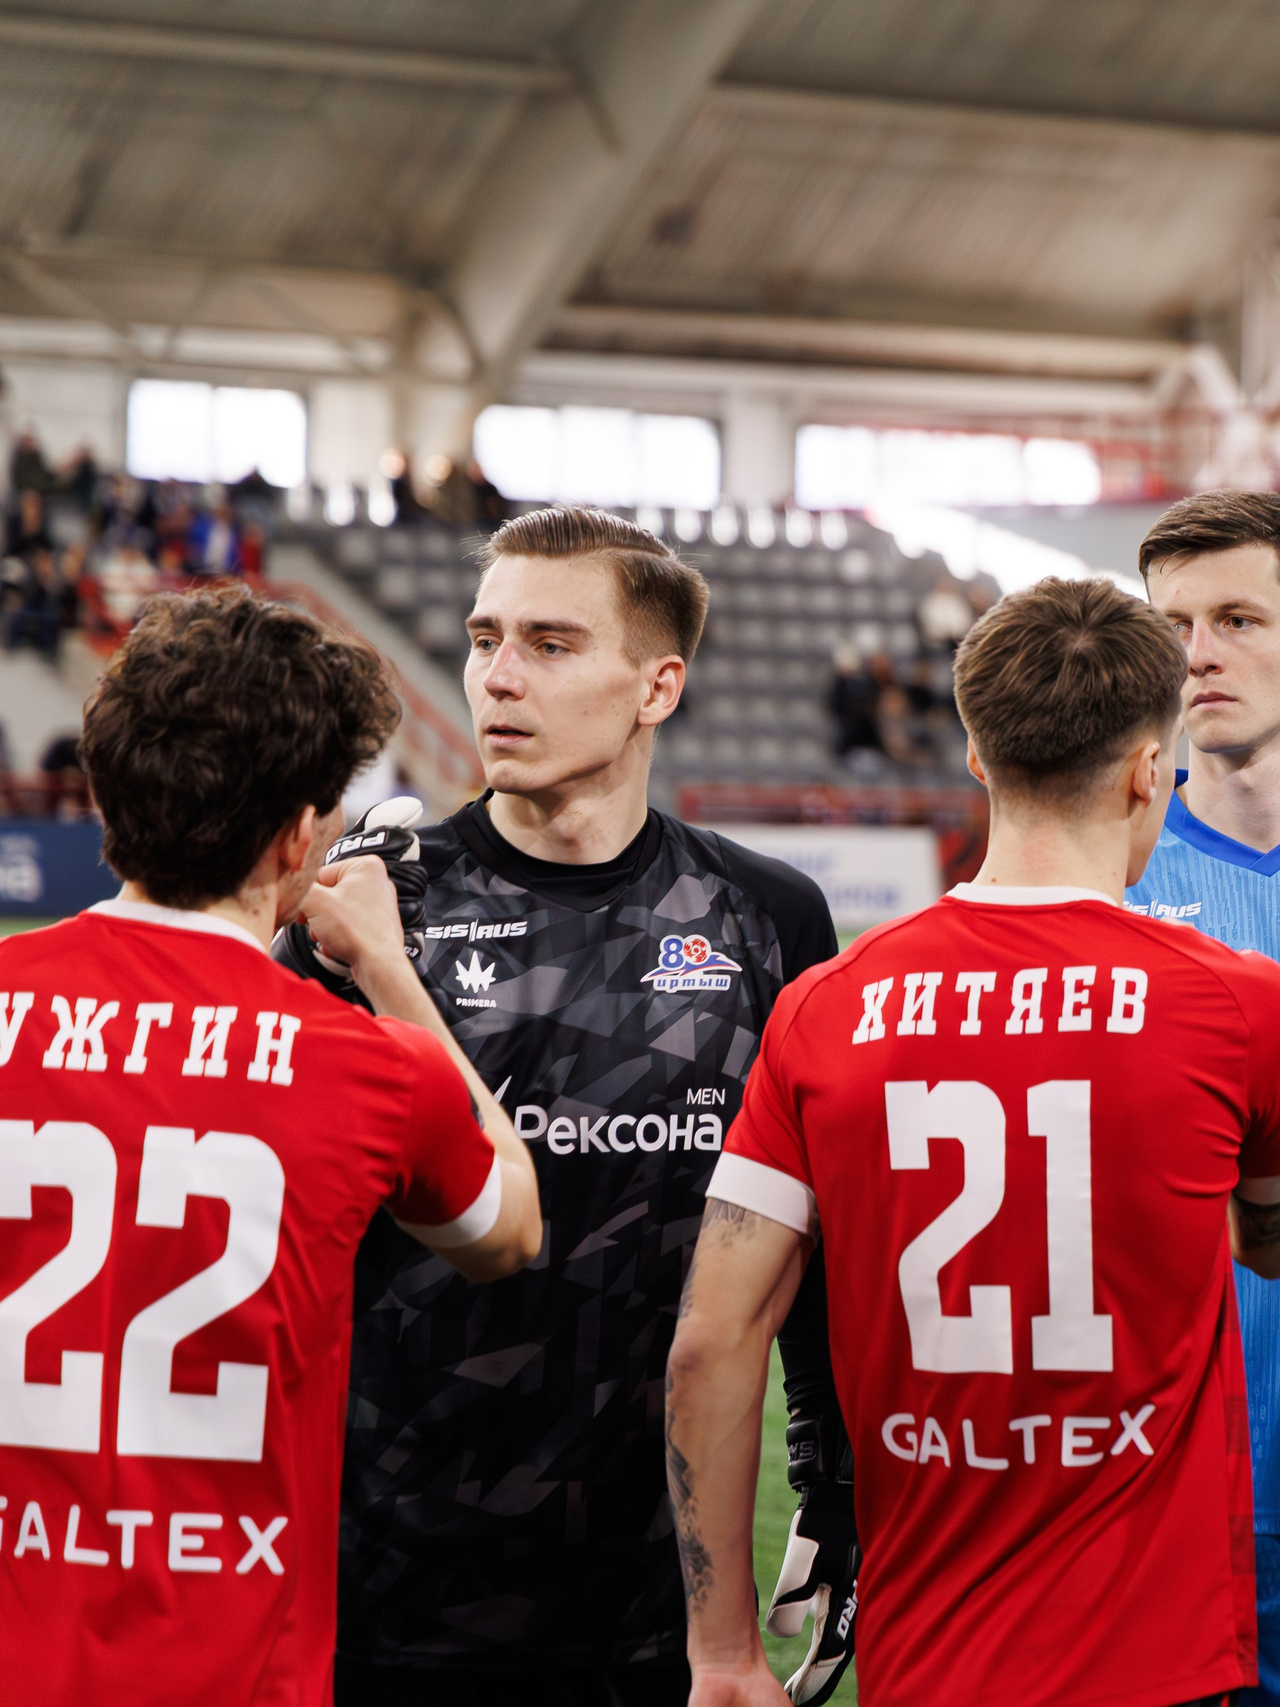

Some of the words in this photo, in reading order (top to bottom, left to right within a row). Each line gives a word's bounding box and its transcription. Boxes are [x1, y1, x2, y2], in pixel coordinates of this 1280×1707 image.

[456, 997, 497, 1008] PRIMERA
[852, 965, 1149, 1045] ХИТЯЕВ
[686, 1087, 725, 1106] MEN
[885, 1079, 1113, 1374] 21
[0, 1119, 285, 1463] 22
[881, 1404, 1156, 1470] GALTEX
[0, 1495, 288, 1575] ALTEX
